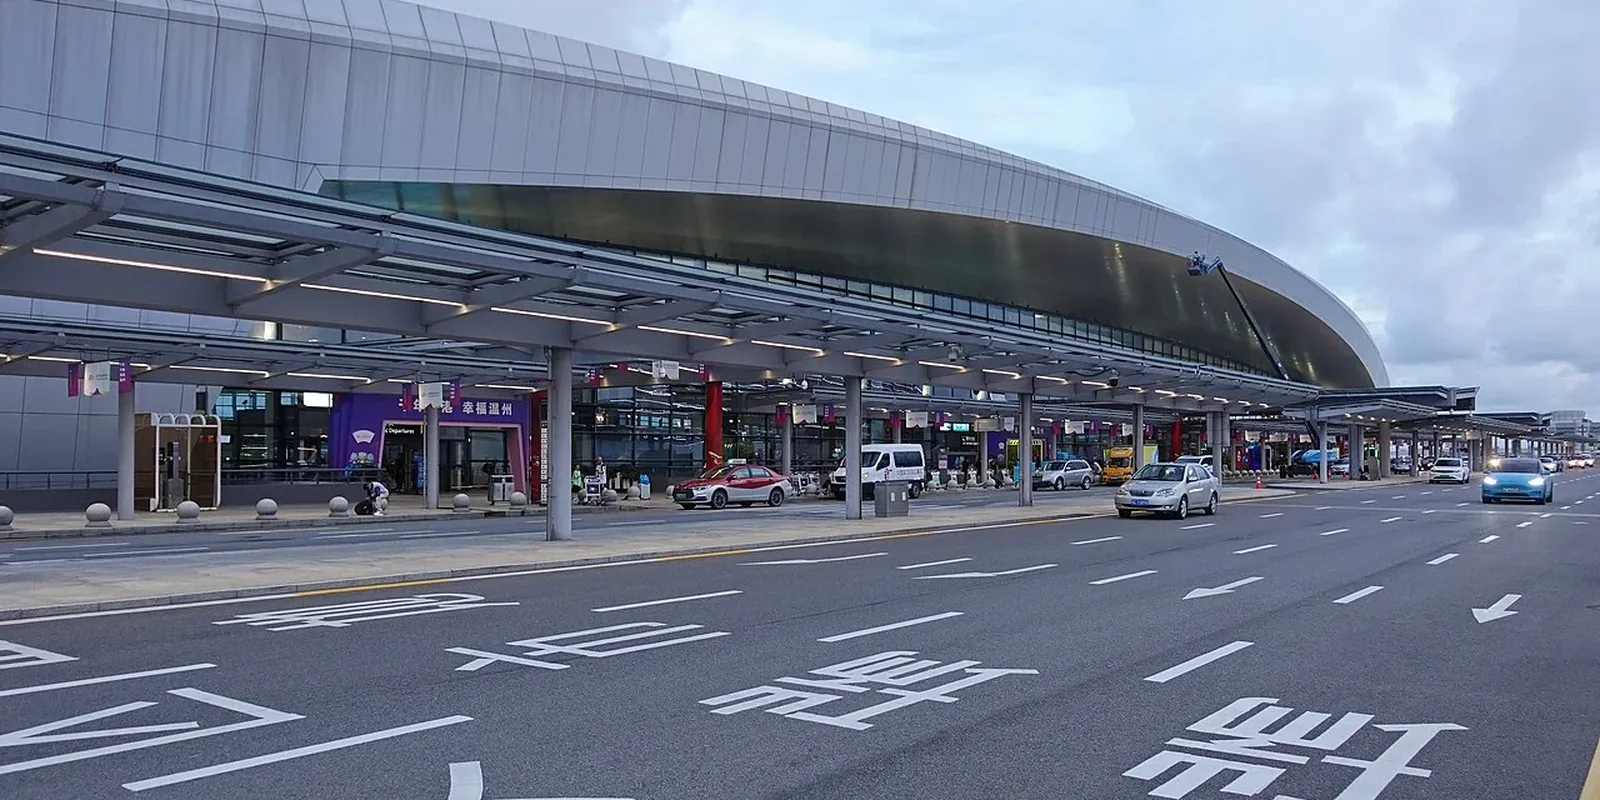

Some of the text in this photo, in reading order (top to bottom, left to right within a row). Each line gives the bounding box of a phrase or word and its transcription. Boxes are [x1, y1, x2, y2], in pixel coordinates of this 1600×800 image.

[462, 400, 513, 416] 幸福温州
[388, 427, 415, 435] Departures
